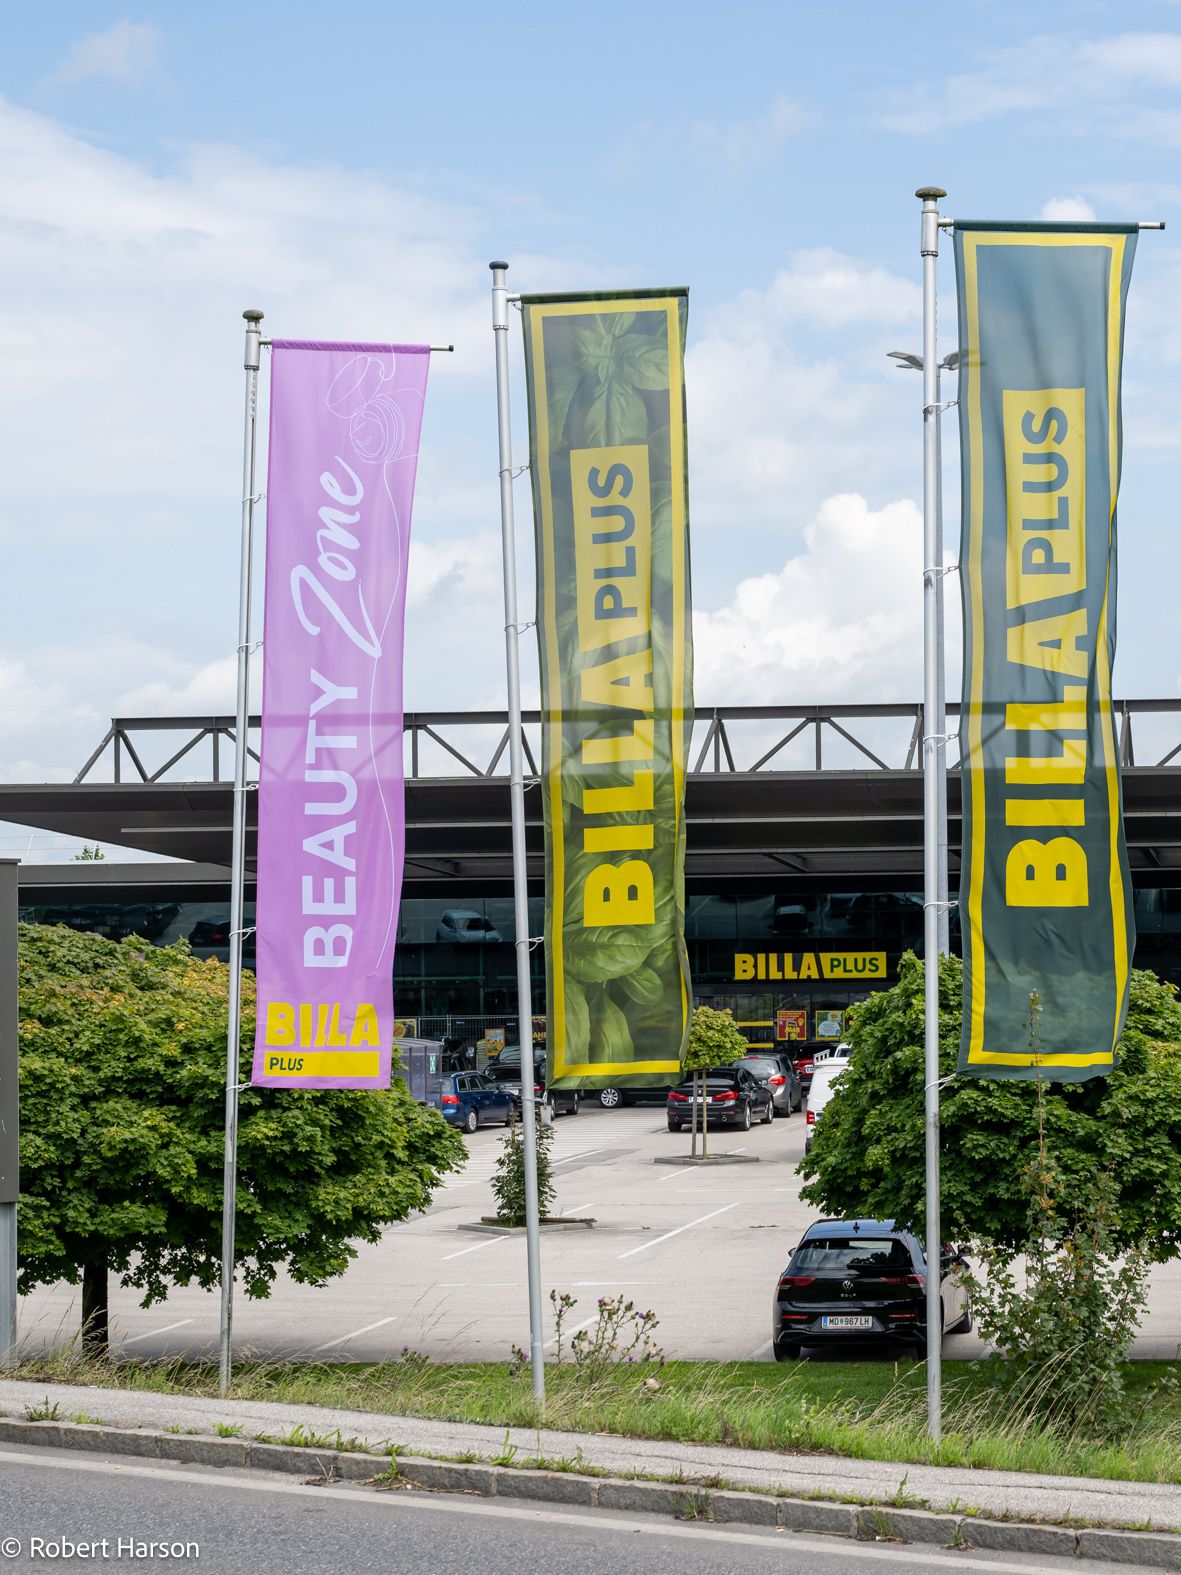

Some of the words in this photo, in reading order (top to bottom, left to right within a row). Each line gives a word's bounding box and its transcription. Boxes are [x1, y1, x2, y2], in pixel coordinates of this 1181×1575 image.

[290, 456, 382, 658] Zone
[588, 463, 638, 620] PLUS
[1021, 406, 1071, 575] PLUS
[301, 671, 358, 968] BEAUTY
[580, 644, 656, 927] BILLA
[1005, 607, 1089, 907] BILLA
[265, 1001, 380, 1048] BILLA
[734, 952, 819, 980] BILLA
[829, 957, 880, 973] PLUS
[269, 1057, 304, 1072] PLUS
